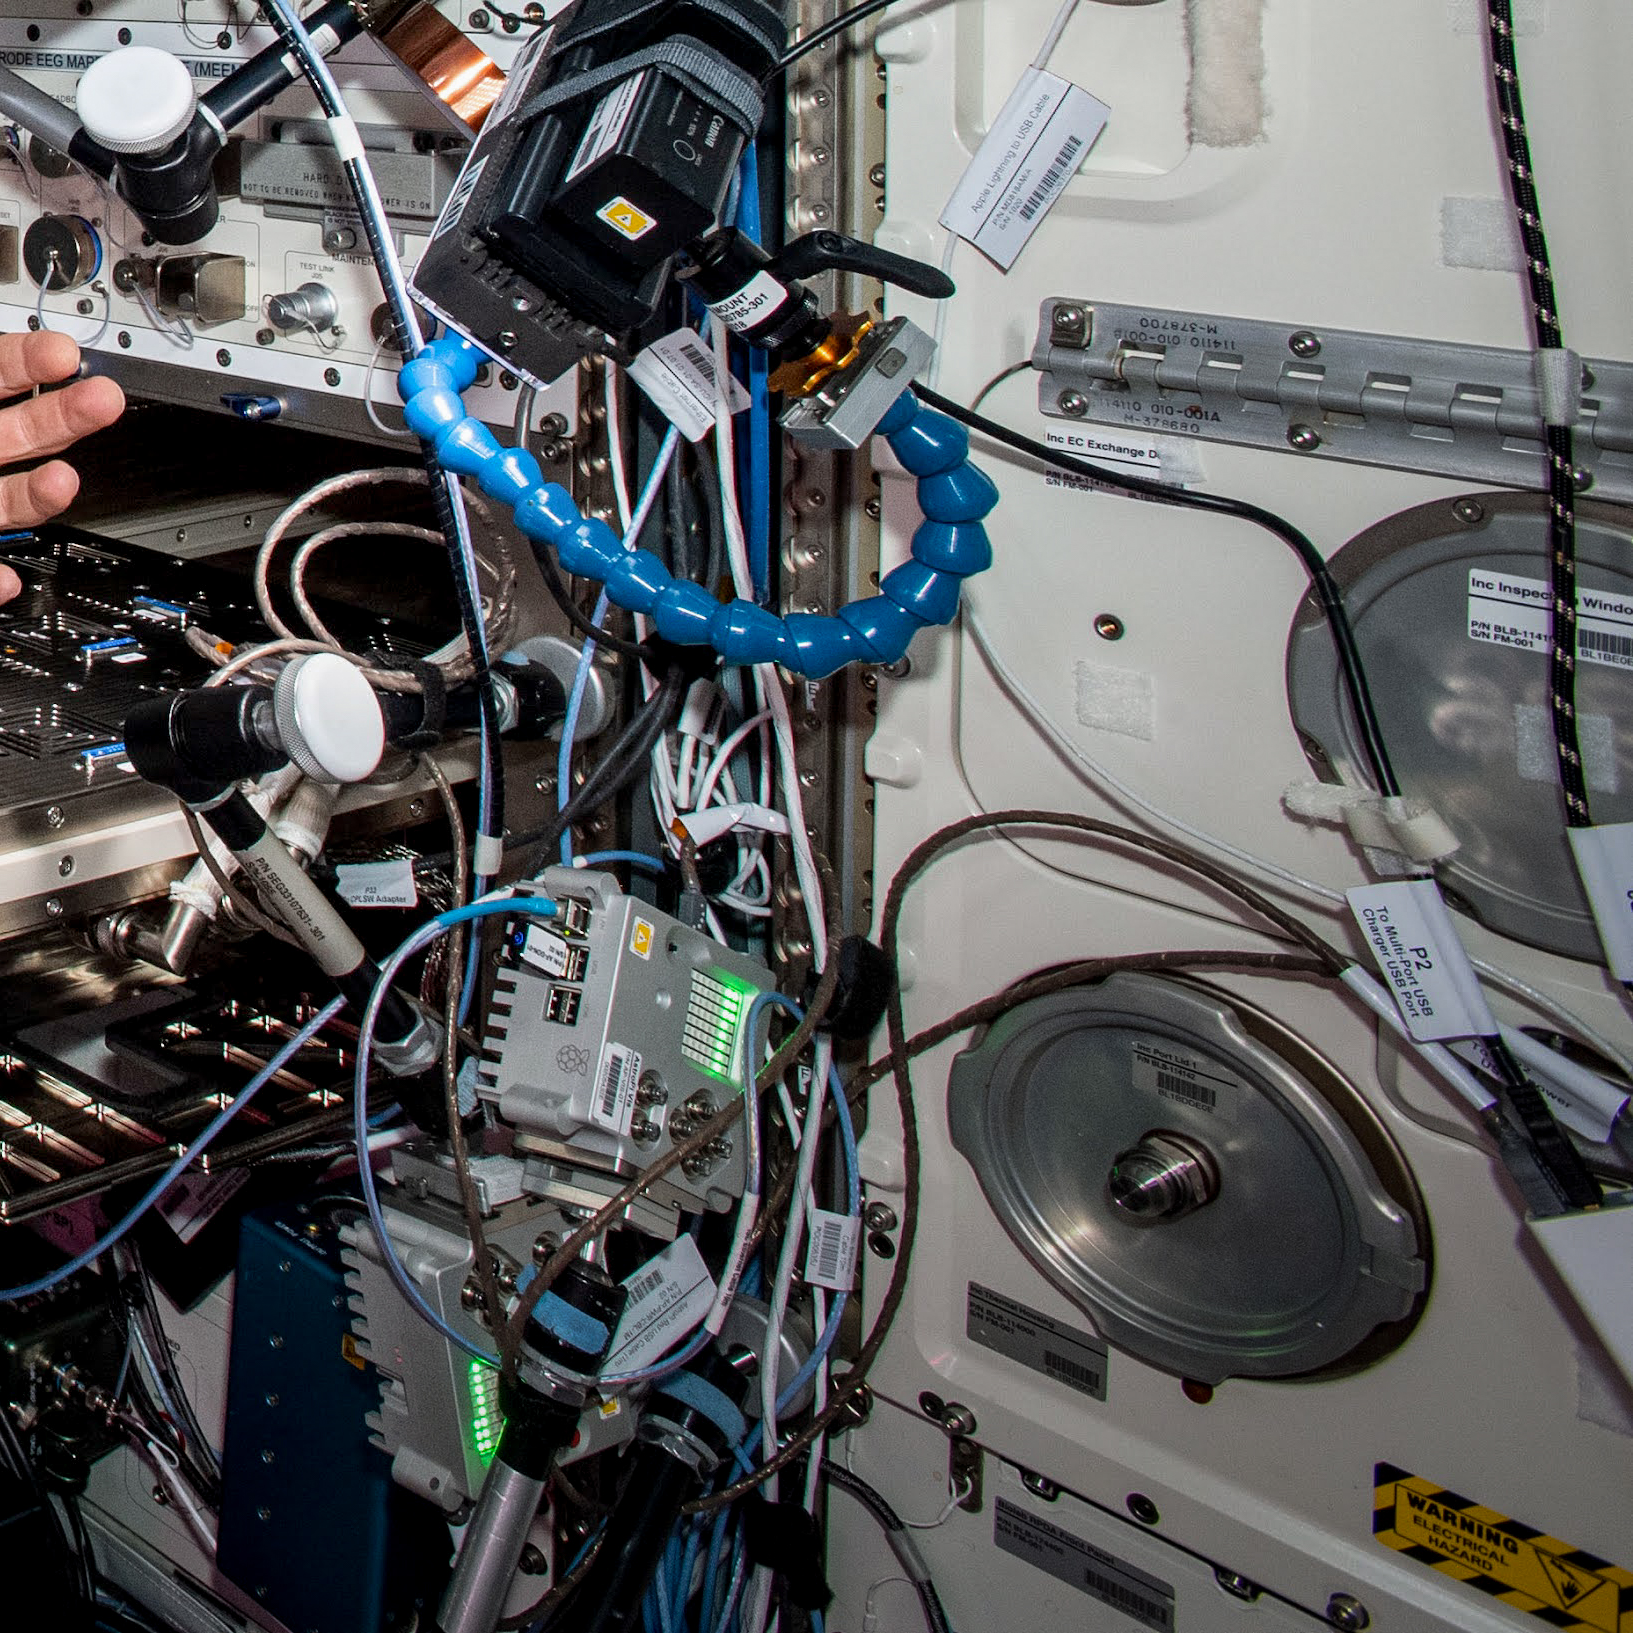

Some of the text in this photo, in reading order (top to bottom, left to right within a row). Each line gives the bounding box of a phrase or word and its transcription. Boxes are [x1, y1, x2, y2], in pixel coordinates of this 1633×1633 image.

[36, 51, 62, 67] EEG
[704, 114, 724, 148] Canon
[971, 190, 990, 214] Apple
[990, 149, 1015, 190] Lightning
[1017, 119, 1033, 141] USB
[1030, 93, 1050, 120] Cable
[272, 186, 281, 195] BE
[300, 262, 316, 270] TEST
[676, 391, 708, 422] Ethernet
[1047, 433, 1145, 457] Inc EC Exchange
[1471, 578, 1495, 590] Inc
[1471, 621, 1490, 631] P/N
[1471, 630, 1534, 648] S/N FM-001
[255, 857, 270, 874] P/N
[1363, 908, 1420, 1019] Charger USB Port
[1376, 905, 1433, 1017] To Multi-Port USB
[1409, 945, 1432, 971] P2
[627, 1055, 641, 1091] AstroPi
[1407, 1492, 1519, 1555] WARNING
[1412, 1515, 1509, 1566] ELECTRICAL
[1427, 1537, 1493, 1572] HAZARD
